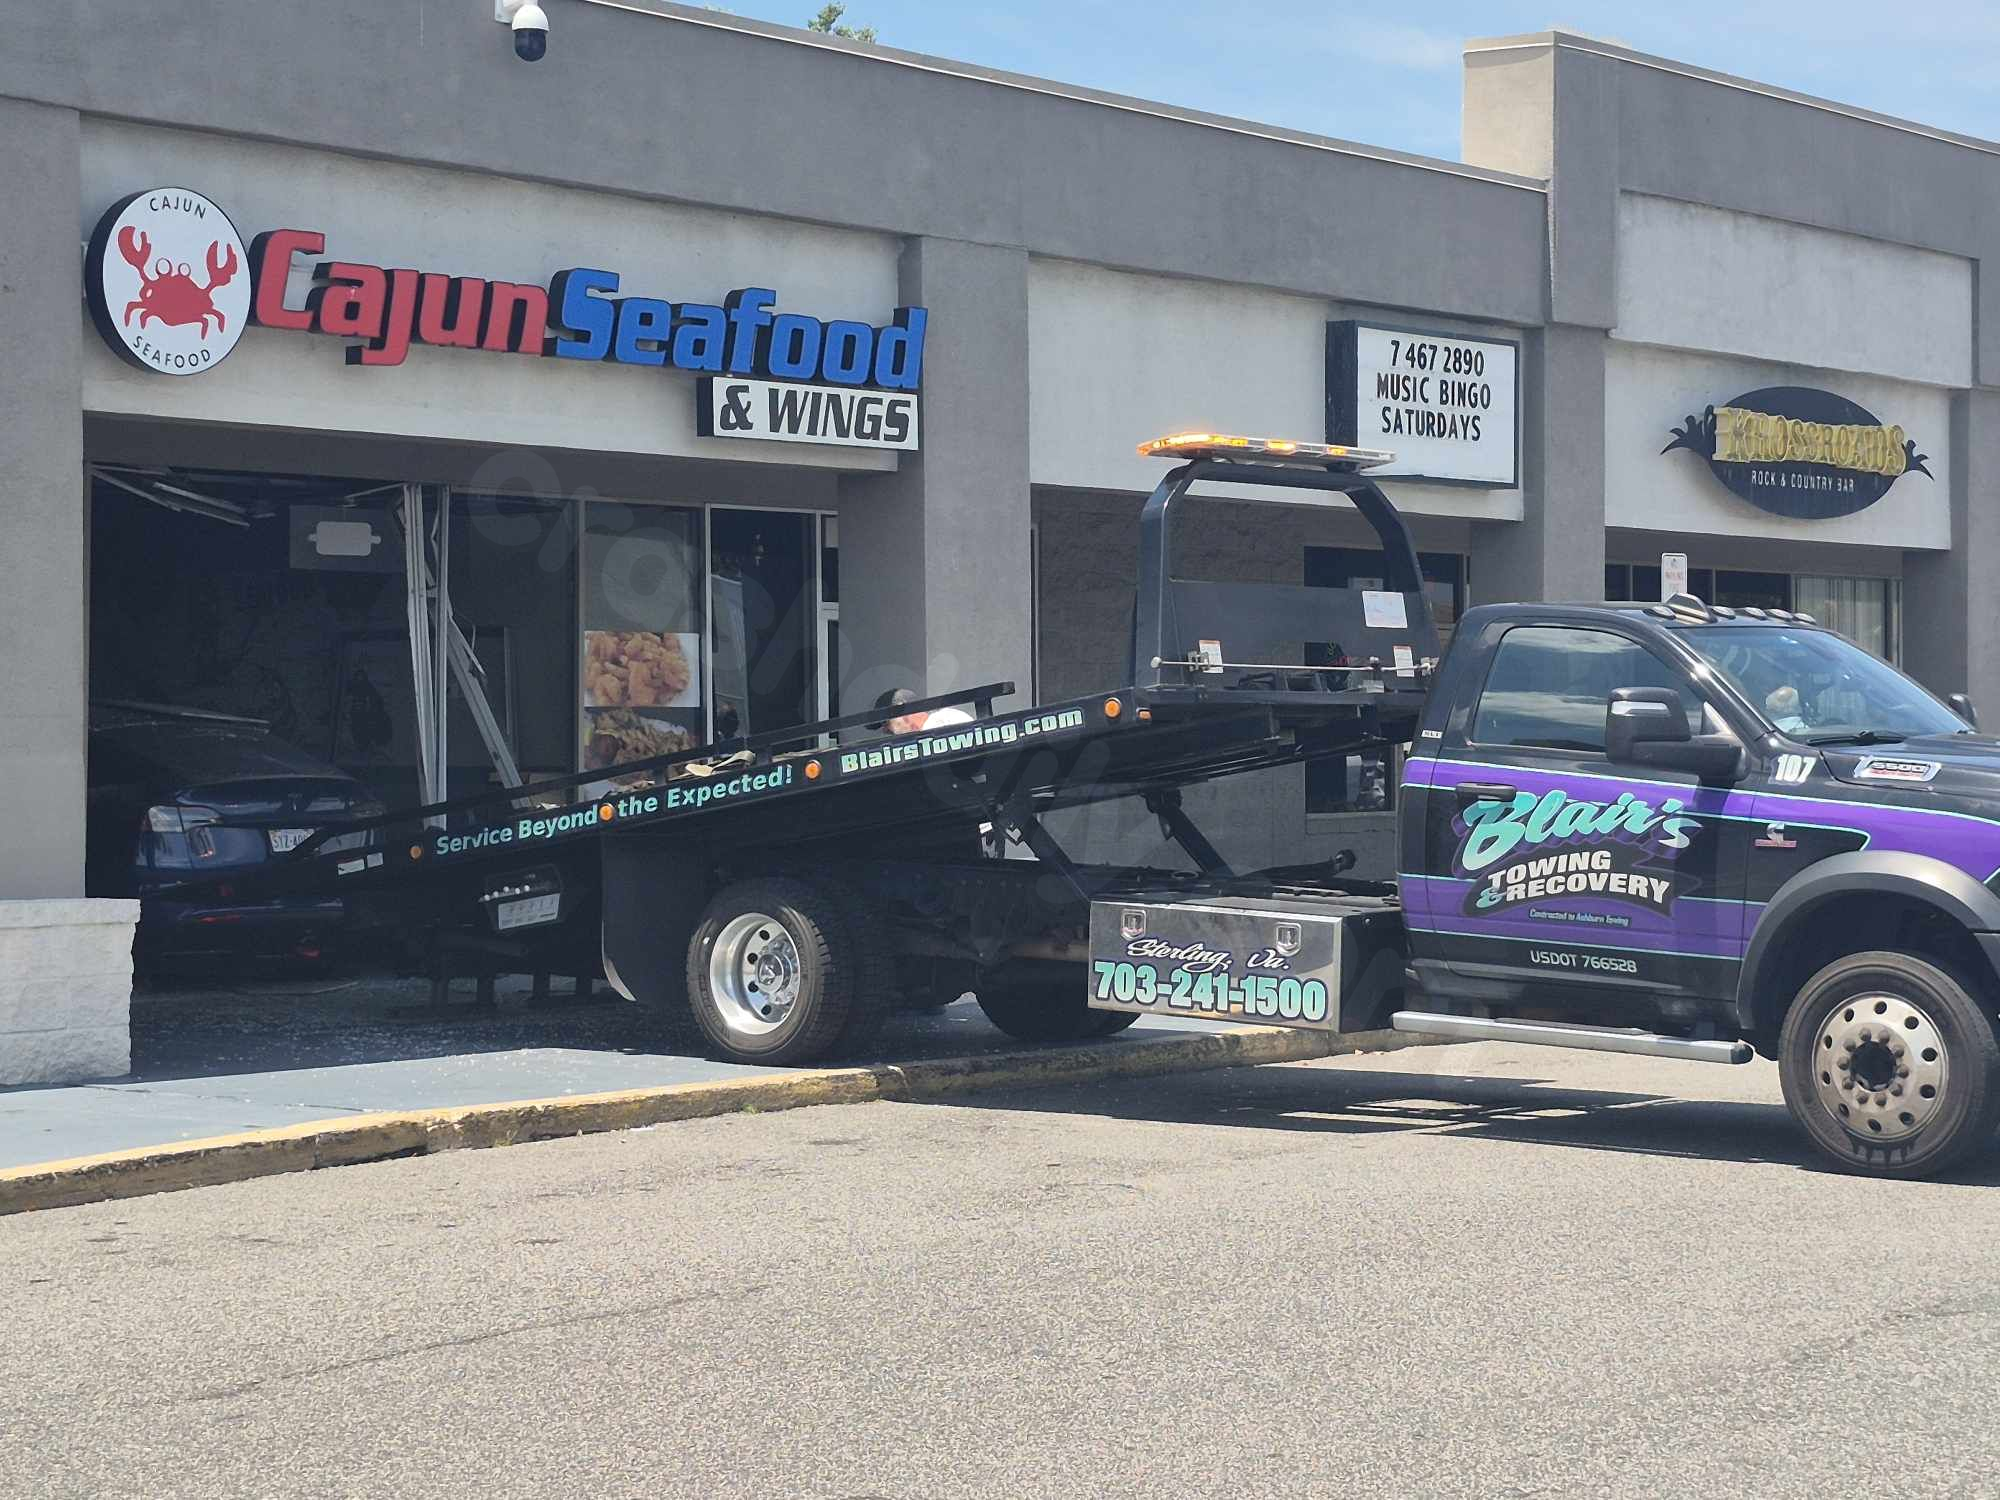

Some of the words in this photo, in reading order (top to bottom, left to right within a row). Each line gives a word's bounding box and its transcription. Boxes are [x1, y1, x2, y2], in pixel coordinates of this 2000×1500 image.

[150, 196, 206, 219] CAJUN
[253, 229, 549, 366] Cajun
[554, 267, 929, 389] Seafood
[133, 336, 211, 368] SEAFOOD
[1390, 340, 1400, 367] 7
[1405, 343, 1438, 371] 467
[1443, 346, 1485, 377] 2890
[1376, 372, 1430, 404] MUSIC
[1439, 379, 1491, 410] BINGO
[719, 384, 754, 431] &
[767, 387, 910, 443] WINGS
[1381, 406, 1482, 442] SATURDAYS
[1751, 469, 1776, 487] ROCK
[1790, 474, 1833, 491] COUNTRY
[1836, 476, 1854, 493] BAR
[841, 708, 1083, 774] BlairsTowing.com
[1775, 753, 1817, 783] 107
[436, 827, 512, 855] Service
[519, 804, 598, 839] Beyond
[618, 796, 657, 818] the
[667, 764, 793, 808] Expected!
[1462, 790, 1703, 871] Blair's
[1488, 850, 1611, 889] TOWING
[1476, 887, 1505, 909] &
[1506, 873, 1672, 904] RECOVERY
[1127, 938, 1233, 973] Sterling,
[1246, 949, 1291, 971] Va.
[1530, 950, 1577, 968] USDOT
[1582, 955, 1638, 973] 766528
[1094, 960, 1326, 1021] 703-241-1500
